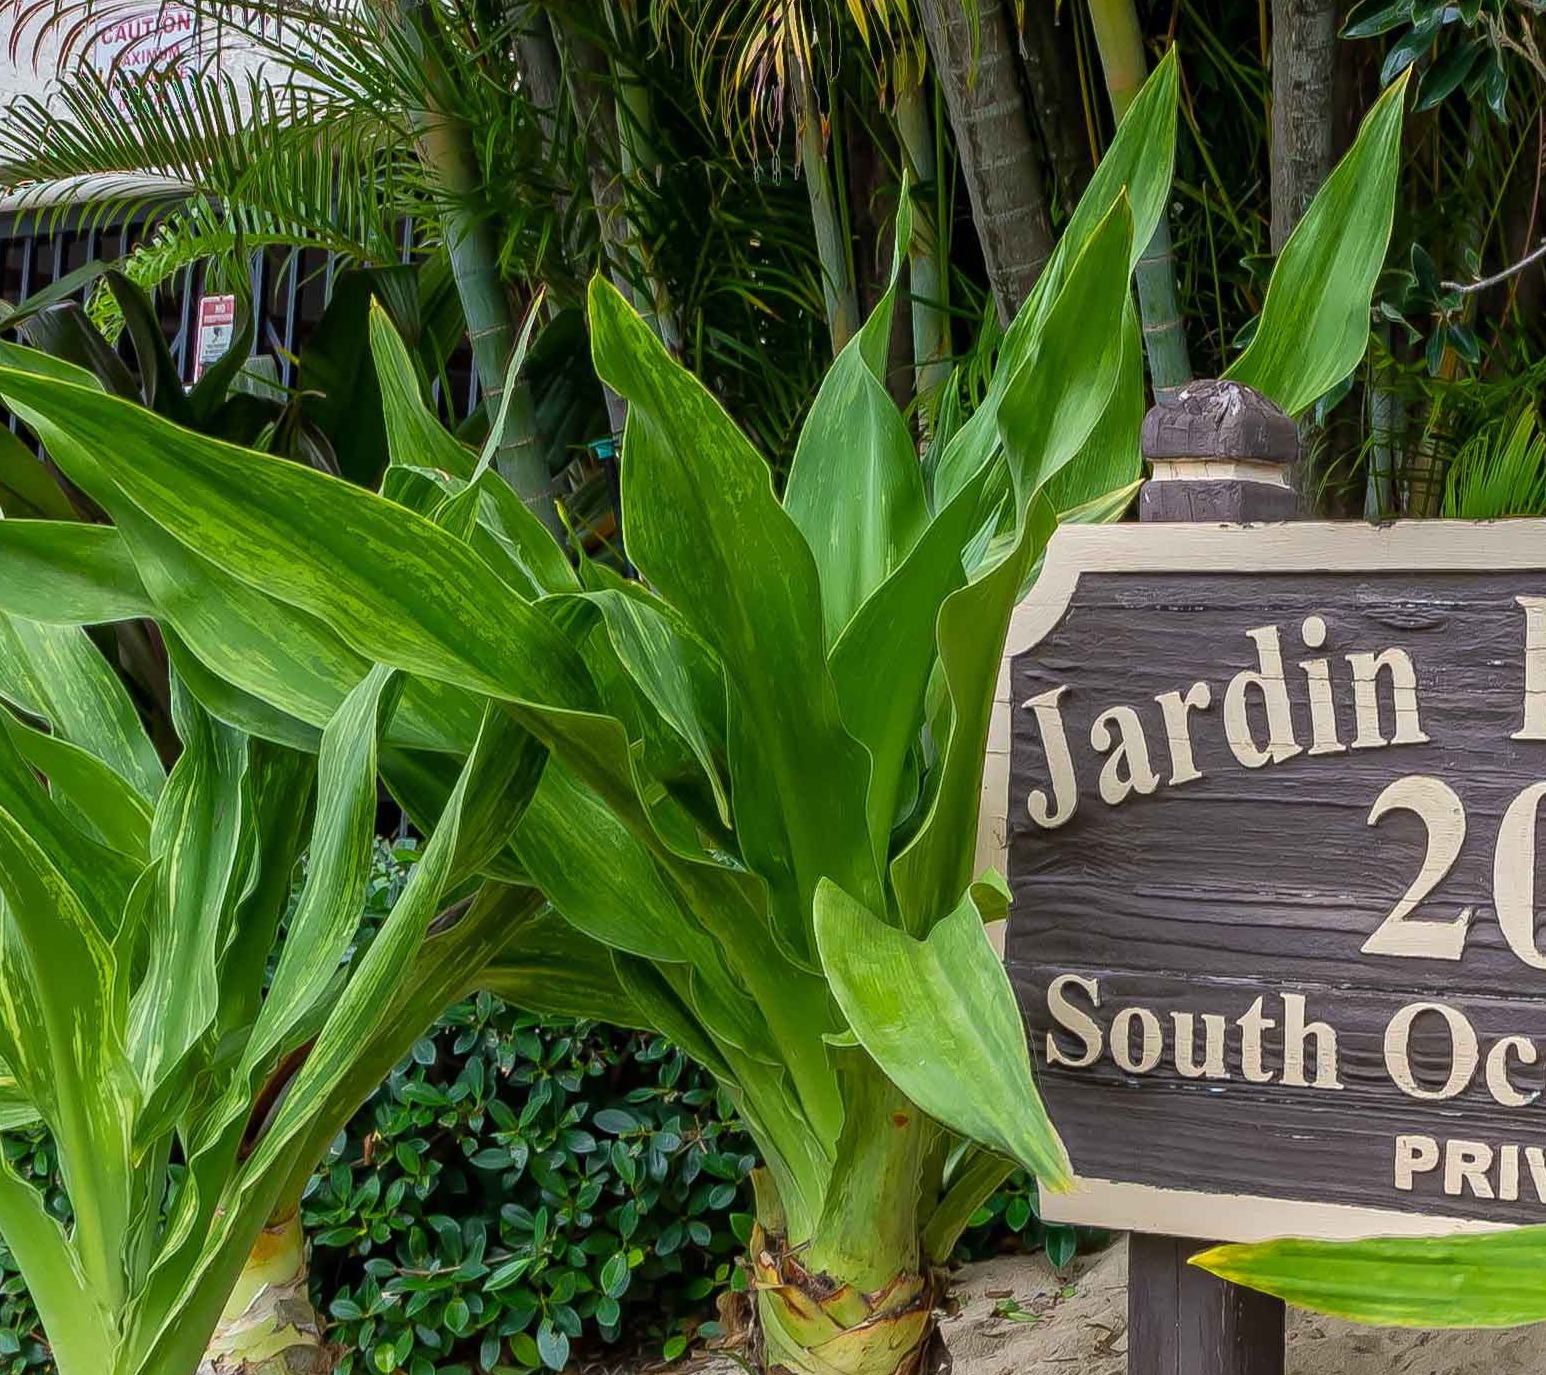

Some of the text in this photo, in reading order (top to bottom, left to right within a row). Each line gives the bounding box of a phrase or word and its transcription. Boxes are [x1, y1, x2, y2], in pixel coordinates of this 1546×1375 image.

[101, 13, 192, 45] CAUTON
[1020, 615, 1432, 829] Jardin
[1045, 973, 1345, 1091] South
